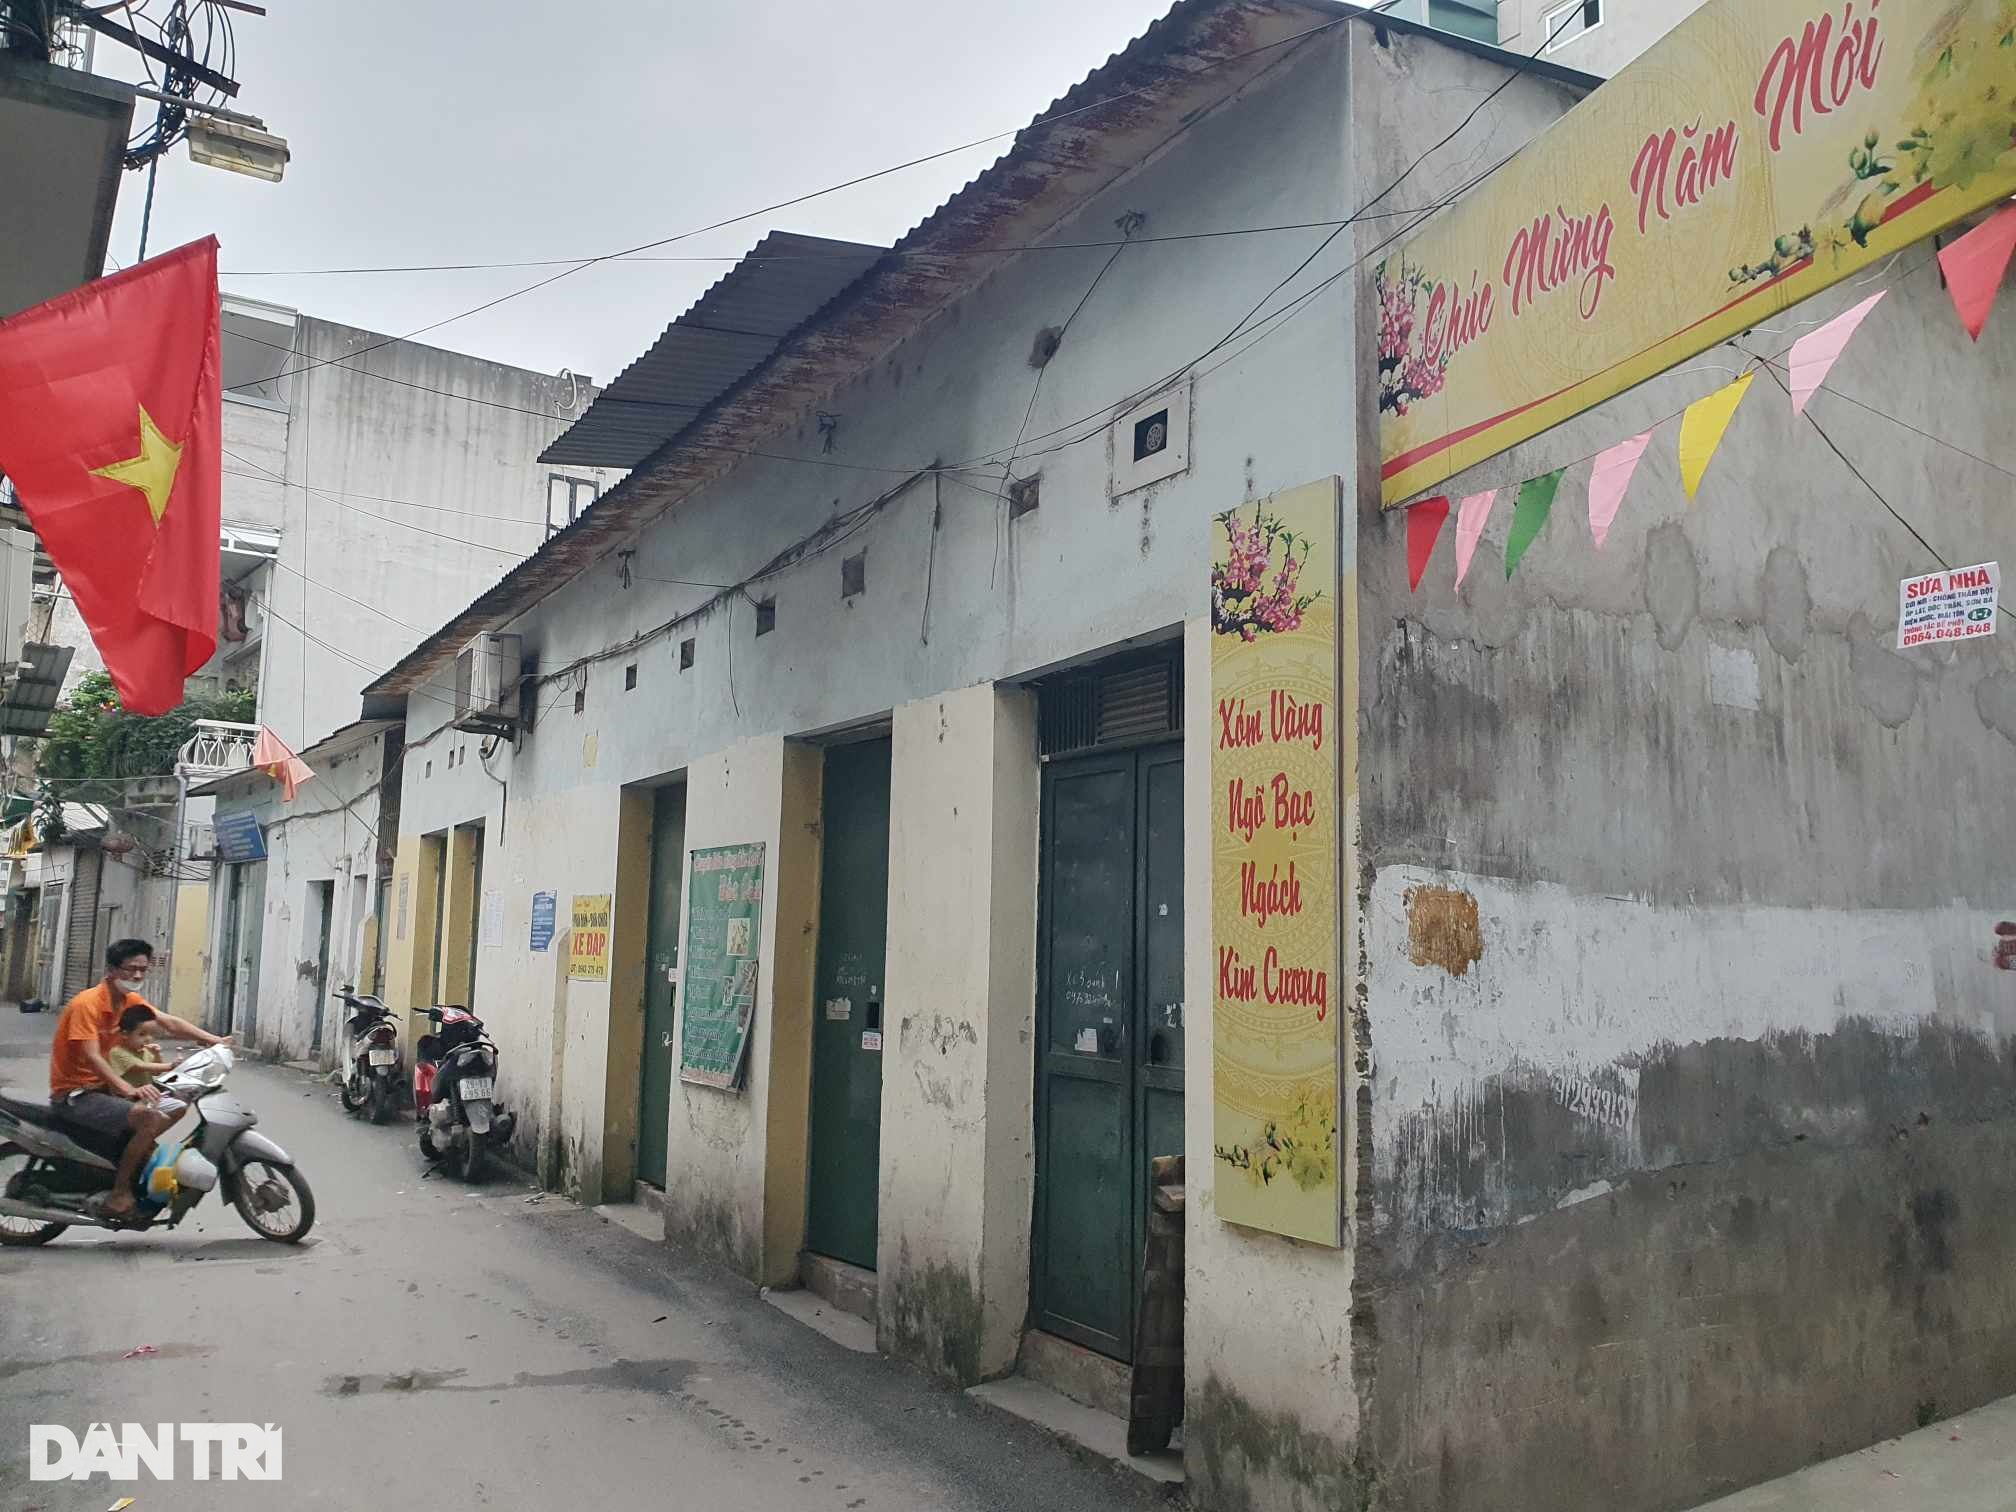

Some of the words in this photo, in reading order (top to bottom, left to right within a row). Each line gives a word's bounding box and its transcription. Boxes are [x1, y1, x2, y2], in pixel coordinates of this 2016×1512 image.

[1424, 269, 1495, 366] Chúc
[1503, 203, 1615, 319] Mừng
[1630, 114, 1739, 234] Năm
[1753, 0, 1885, 151] Mới
[1907, 576, 1944, 599] SỬA
[1219, 698, 1264, 750] Xóm
[1271, 689, 1322, 750] Vàng
[1229, 776, 1266, 843] Ngõ
[1271, 772, 1315, 841] Bạc
[1241, 860, 1302, 928] Ngách
[572, 932, 585, 956] XE
[1219, 945, 1258, 1002] Kim
[1264, 945, 1327, 1022] Cương
